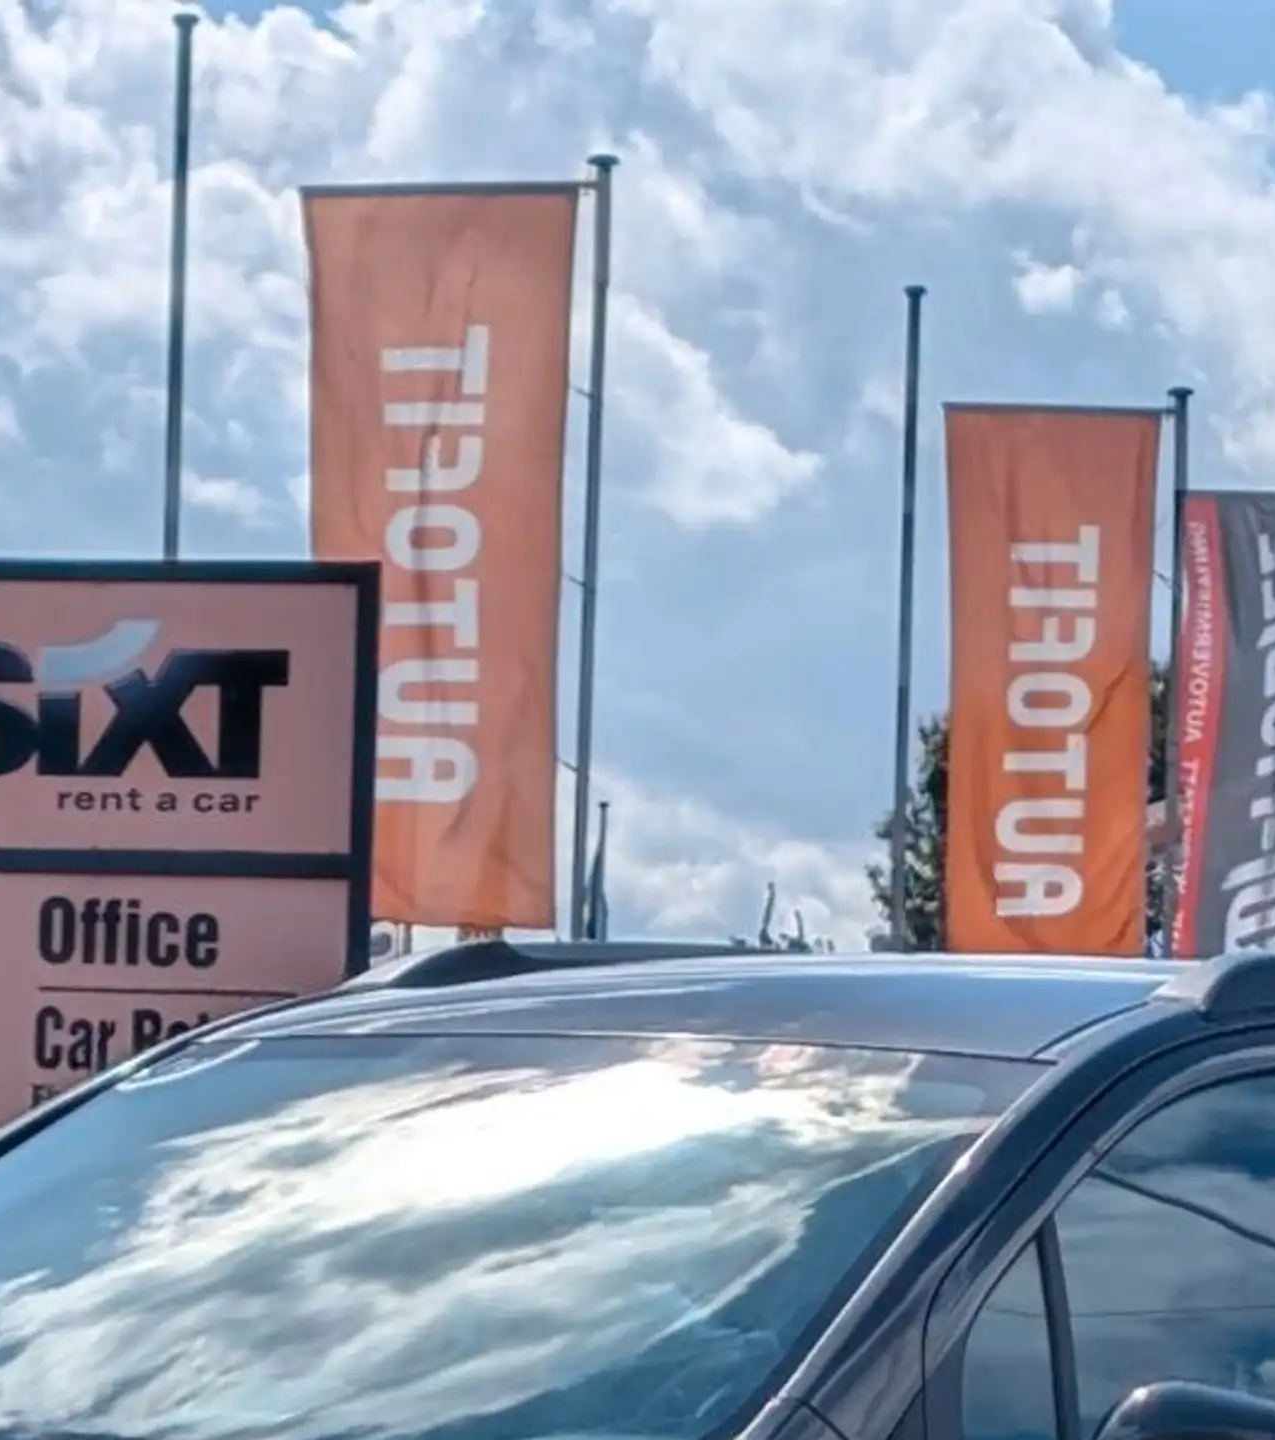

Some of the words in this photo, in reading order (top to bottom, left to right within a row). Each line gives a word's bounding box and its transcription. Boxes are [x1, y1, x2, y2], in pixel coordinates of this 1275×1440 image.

[57, 787, 143, 812] rent
[155, 792, 177, 812] a
[192, 792, 261, 814] car
[38, 896, 220, 969] Office
[35, 1005, 116, 1072] Car
